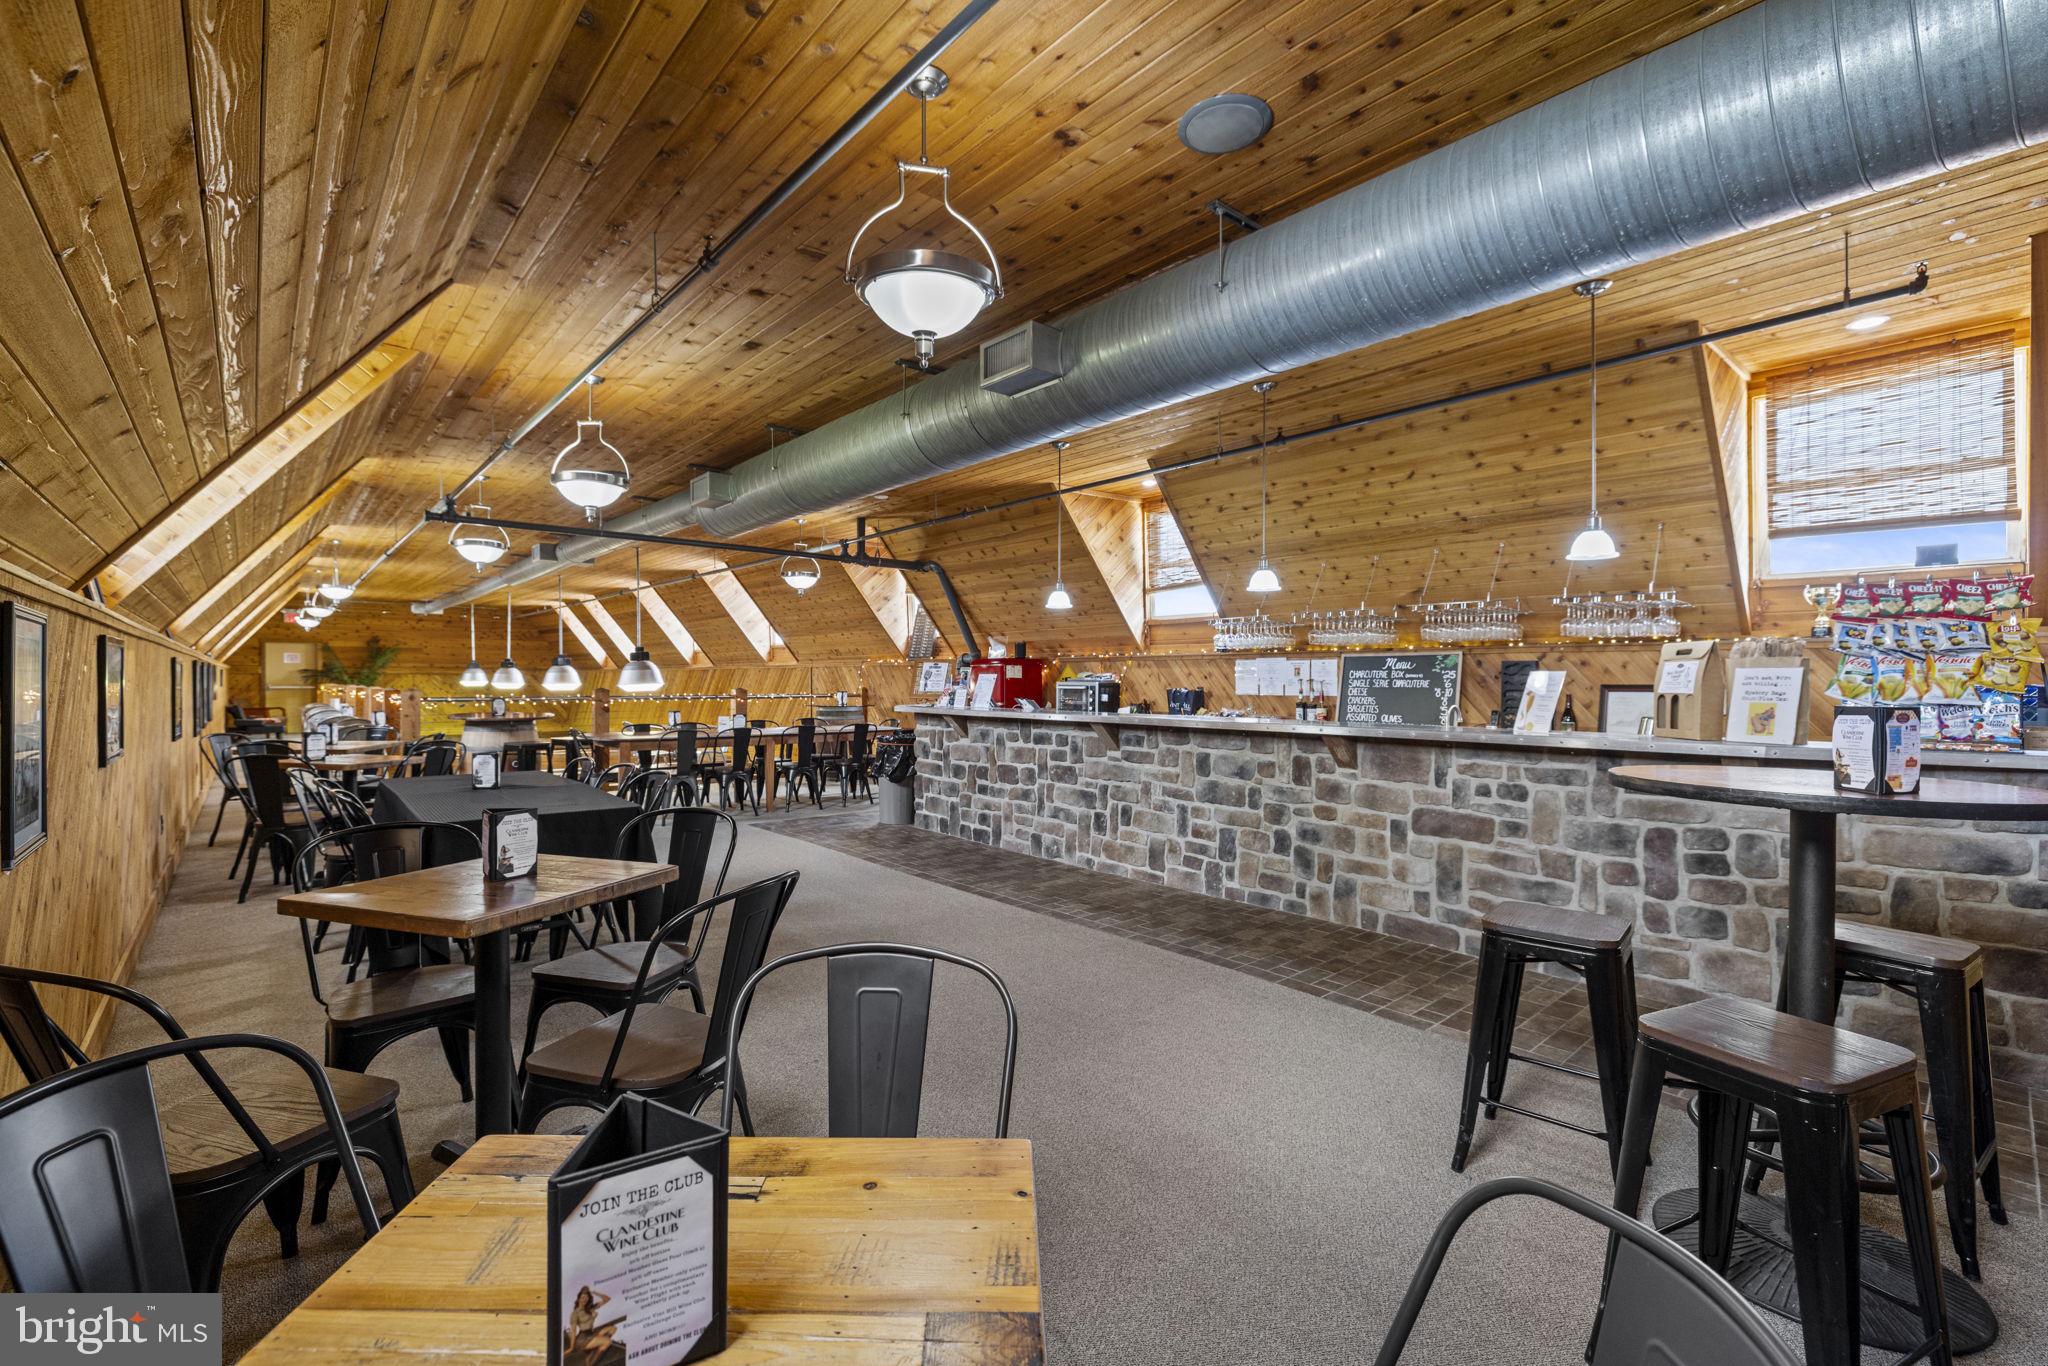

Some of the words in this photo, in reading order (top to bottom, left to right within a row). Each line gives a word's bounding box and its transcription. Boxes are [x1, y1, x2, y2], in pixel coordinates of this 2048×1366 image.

[1382, 658, 1416, 669] Menu
[1349, 680, 1369, 688] SINGLE
[1348, 688, 1368, 696] CHEESE
[1348, 697, 1376, 705] CRACKERS
[1347, 705, 1379, 714] BAGUETTES
[1346, 714, 1377, 722] ASSORTED
[1381, 715, 1403, 723] OLIVES
[580, 1195, 621, 1218] JOIN
[627, 1184, 659, 1204] THE
[664, 1171, 704, 1193] CLUB
[596, 1207, 686, 1243] CLANDESTINE
[603, 1235, 640, 1253] WINE
[643, 1223, 679, 1241] CLUB
[621, 1250, 638, 1258] Enjoy
[628, 1262, 651, 1274] Member
[622, 1281, 650, 1294] Exclusive
[651, 1274, 674, 1285] Member
[689, 1263, 708, 1272] events
[624, 1289, 649, 1301] Voucher
[663, 1272, 705, 1289] complimentary
[634, 1296, 649, 1304] Wine
[650, 1290, 668, 1300] Flight
[669, 1285, 682, 1293] with
[623, 1315, 651, 1328] Exclusive
[693, 1296, 706, 1305] Club
[643, 1315, 671, 1329] Challenge
[644, 1333, 657, 1342] AND
[628, 1352, 639, 1360] ASK
[641, 1344, 659, 1356] ABOUT
[660, 1335, 682, 1349] JOINING
[683, 1331, 693, 1340] THE
